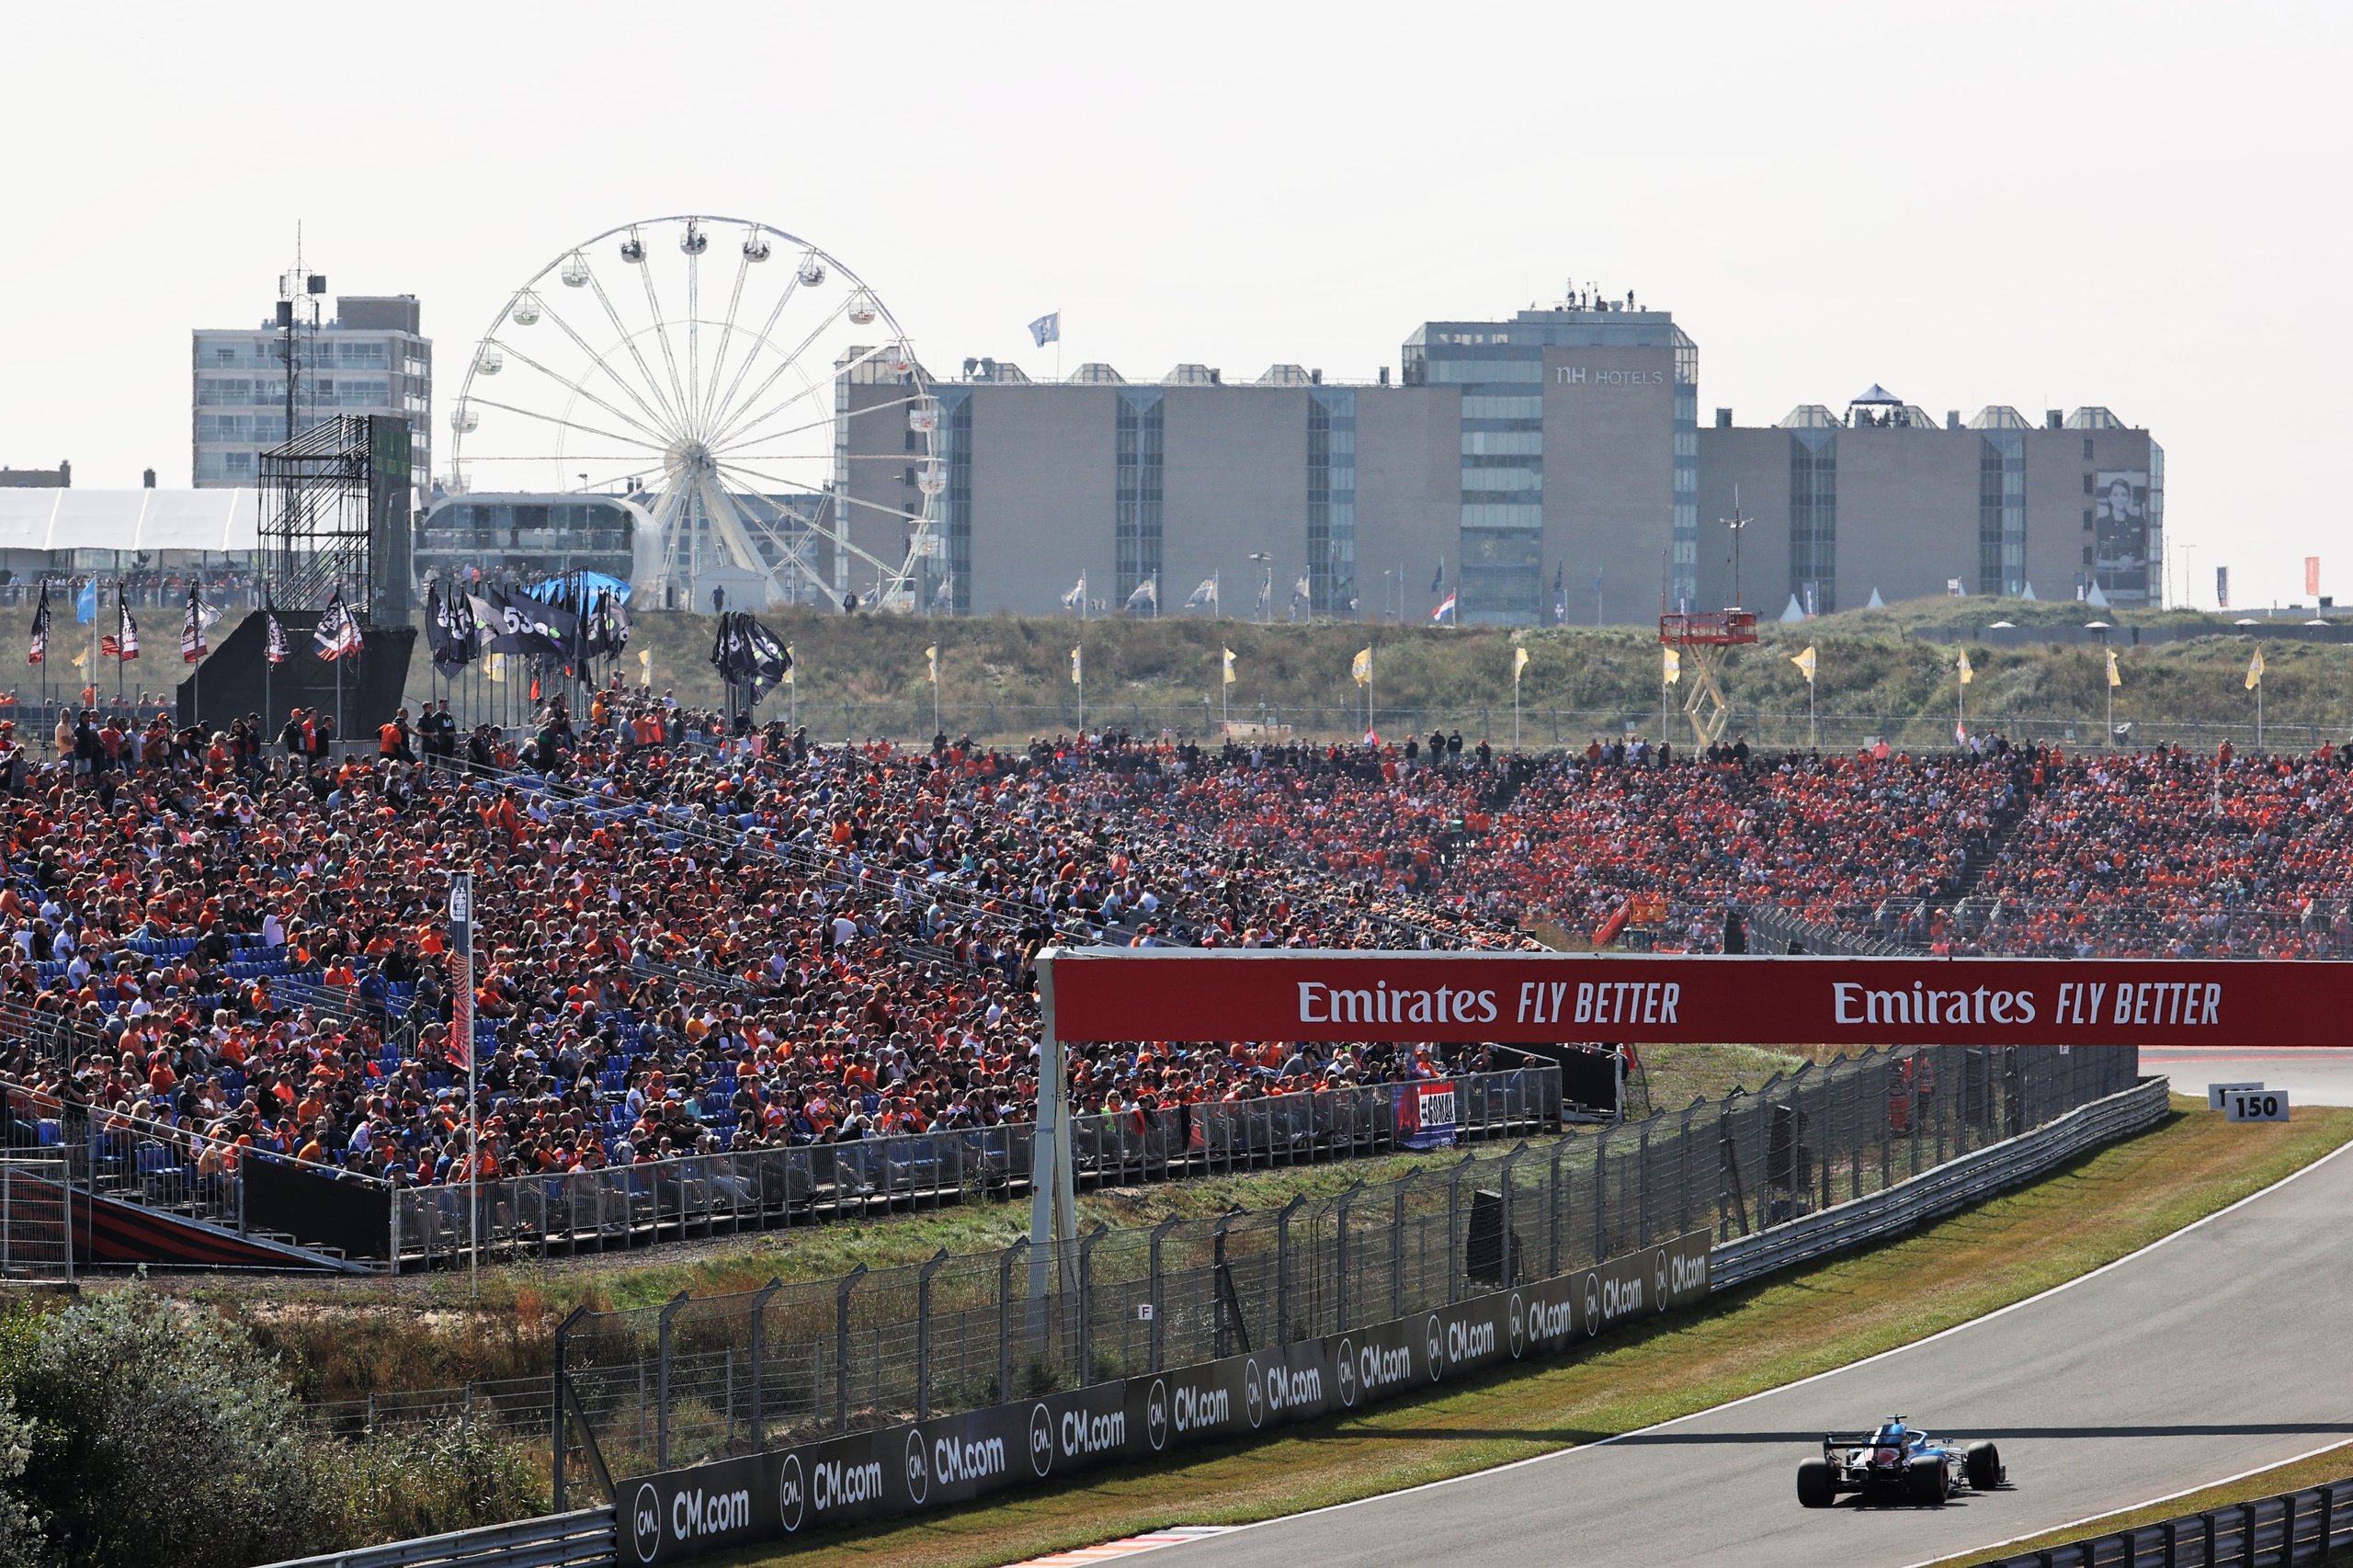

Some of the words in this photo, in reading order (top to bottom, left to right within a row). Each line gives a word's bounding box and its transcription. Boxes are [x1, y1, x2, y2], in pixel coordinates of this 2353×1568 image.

[1596, 370, 1664, 384] HOTELS
[1297, 980, 1498, 1024] Emirates
[1517, 983, 1567, 1023] FLY
[1574, 983, 1681, 1024] BETTER
[1832, 980, 2037, 1025] Emirates
[2055, 983, 2107, 1024] FLY
[2113, 983, 2222, 1025] BETTER
[2235, 1096, 2278, 1119] 150
[1671, 1253, 1706, 1294] CM.com
[1142, 1306, 1150, 1318] F
[1603, 1277, 1642, 1319] CM.com
[1449, 1319, 1495, 1363] CM.com
[1529, 1299, 1571, 1343] CM.com
[1267, 1365, 1322, 1411] CM.com
[1360, 1343, 1411, 1389] CM.com
[1151, 1403, 1165, 1426] CM.
[1174, 1385, 1229, 1432] CM.com
[1034, 1427, 1051, 1453] CM.
[1062, 1409, 1125, 1457] CM.com
[909, 1455, 926, 1479] CM.
[935, 1436, 1006, 1484] CM.com
[783, 1481, 801, 1506] CM.
[813, 1460, 882, 1510] CM.com
[638, 1509, 658, 1537] CM.
[672, 1487, 749, 1540] CM.com
